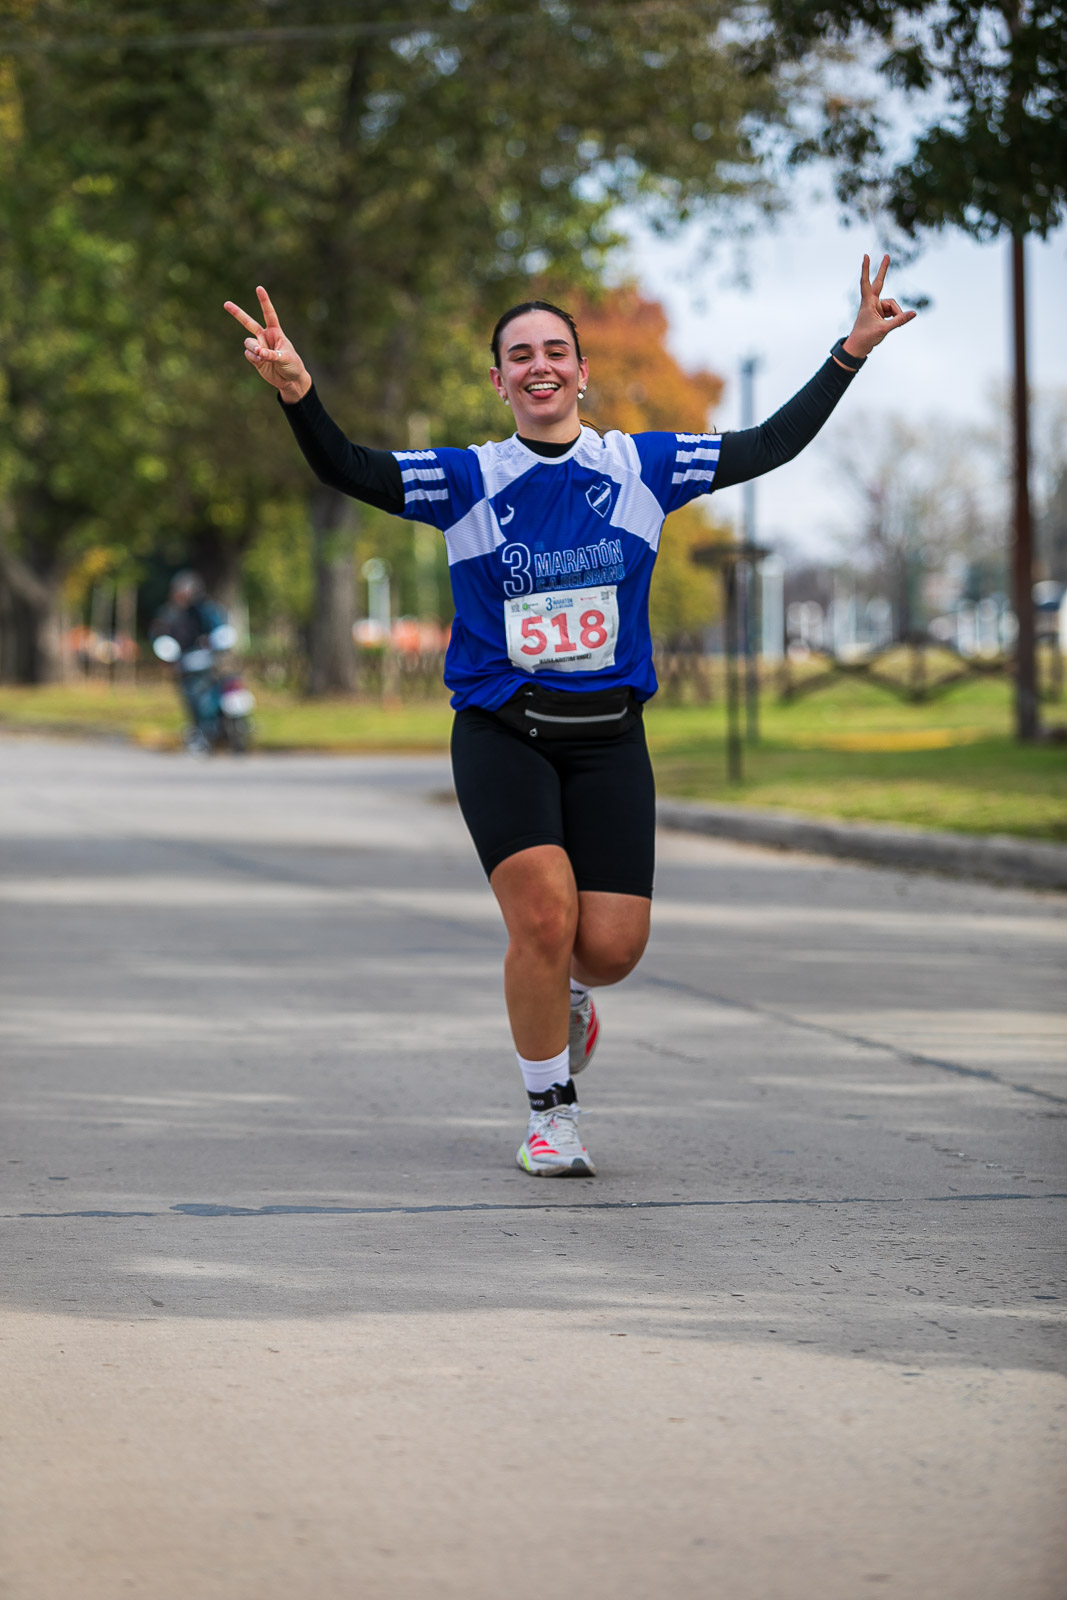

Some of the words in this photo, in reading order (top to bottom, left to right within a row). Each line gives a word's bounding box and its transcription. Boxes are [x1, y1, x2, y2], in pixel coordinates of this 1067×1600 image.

[502, 543, 533, 597] 3
[534, 538, 624, 577] MARATÓN
[545, 597, 553, 611] 3
[520, 609, 608, 655] 518
